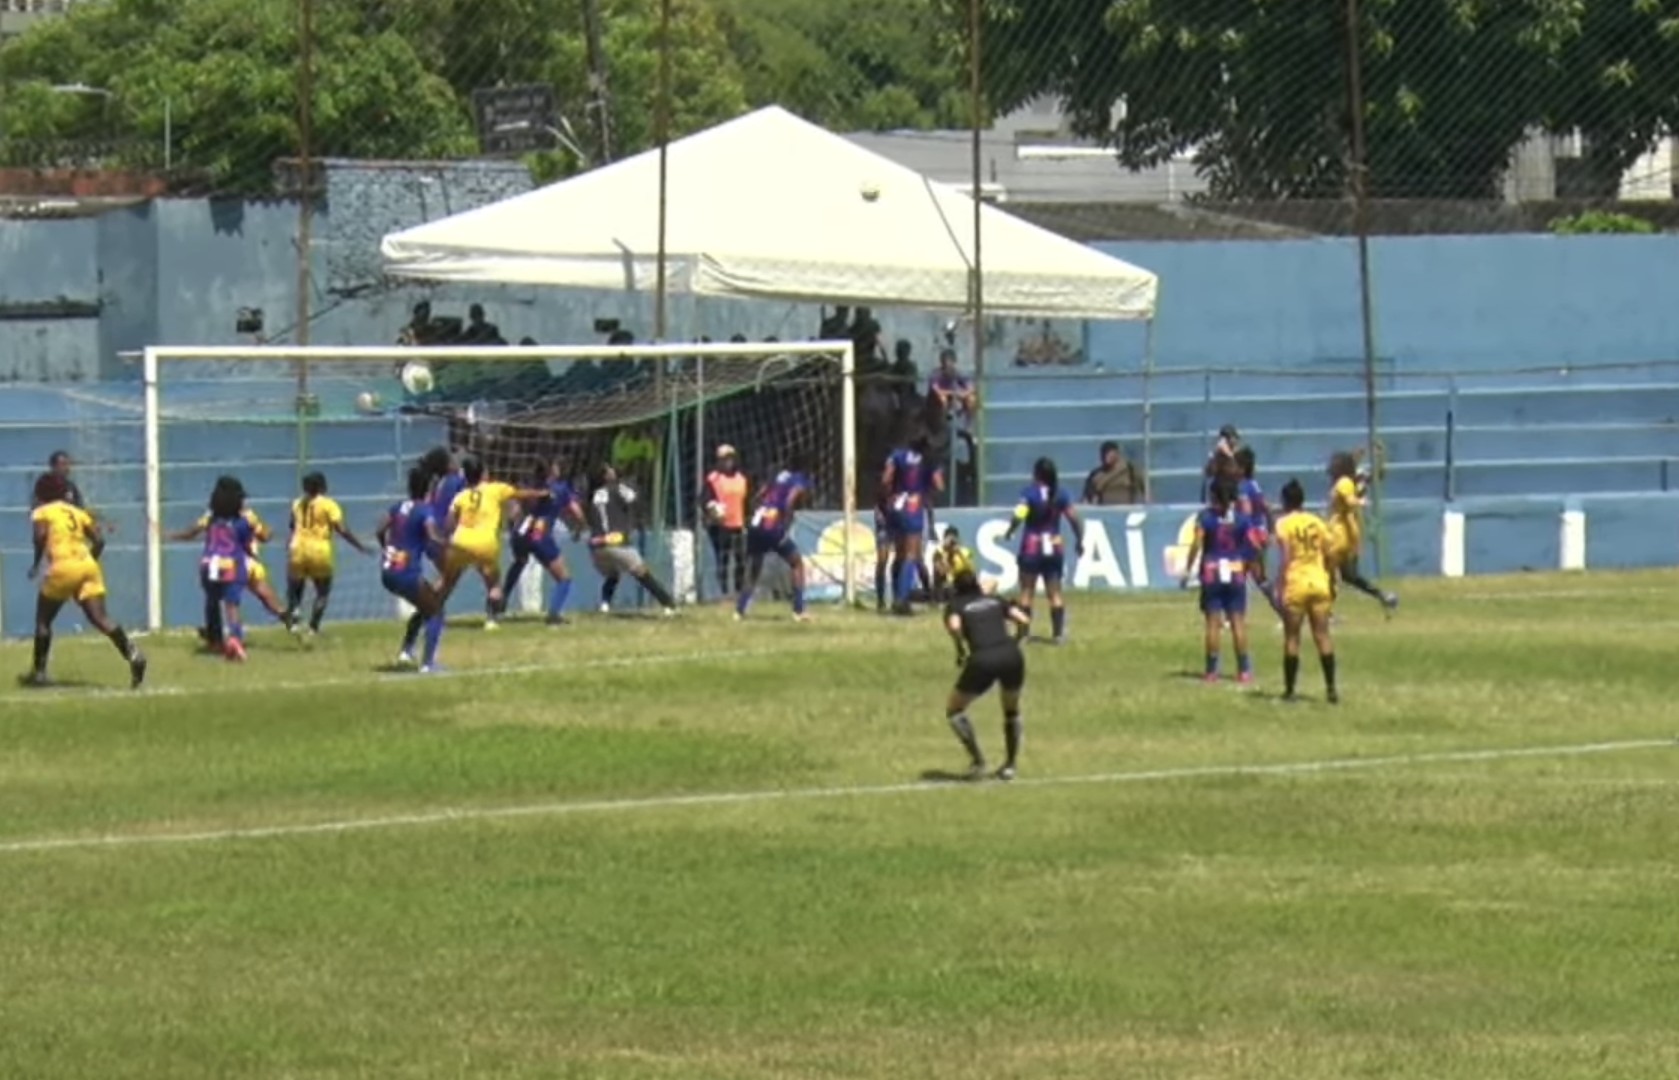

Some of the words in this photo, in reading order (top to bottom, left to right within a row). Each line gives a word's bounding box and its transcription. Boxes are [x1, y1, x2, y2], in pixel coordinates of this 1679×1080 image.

[468, 489, 483, 513] 9
[63, 507, 77, 533] 3
[916, 512, 1150, 592] SAÍ
